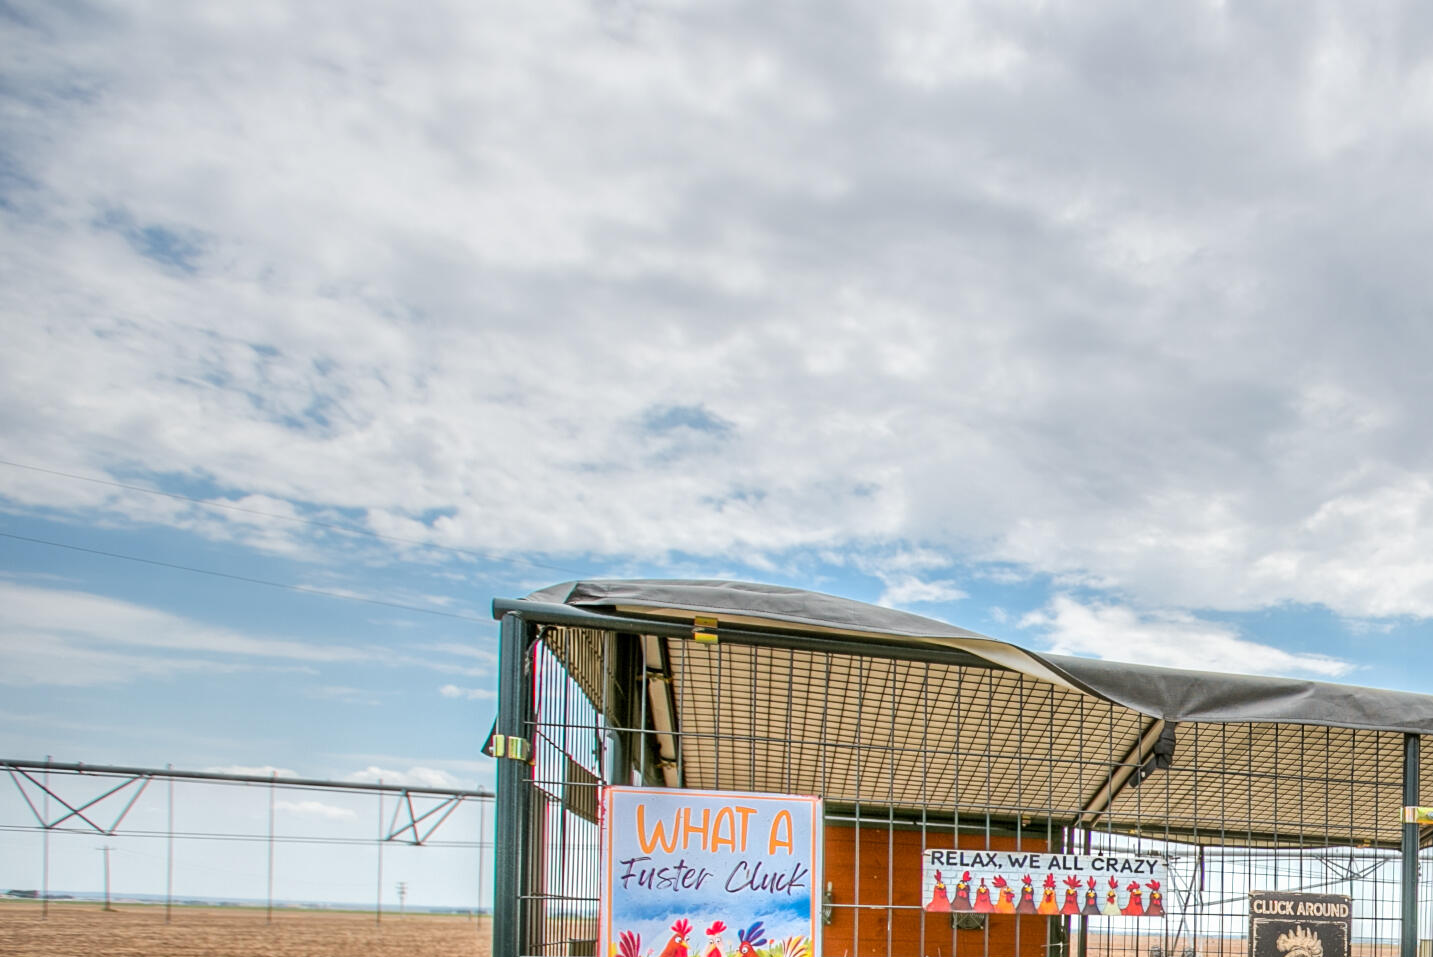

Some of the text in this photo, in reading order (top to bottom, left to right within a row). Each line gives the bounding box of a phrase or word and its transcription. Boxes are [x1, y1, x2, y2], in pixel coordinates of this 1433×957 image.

[637, 804, 793, 855] WHAT A
[619, 856, 809, 895] Fuster Cluck
[931, 850, 1158, 875] RELAX, WE ALL CRAZY
[1253, 900, 1349, 918] CLUCK AROUND
